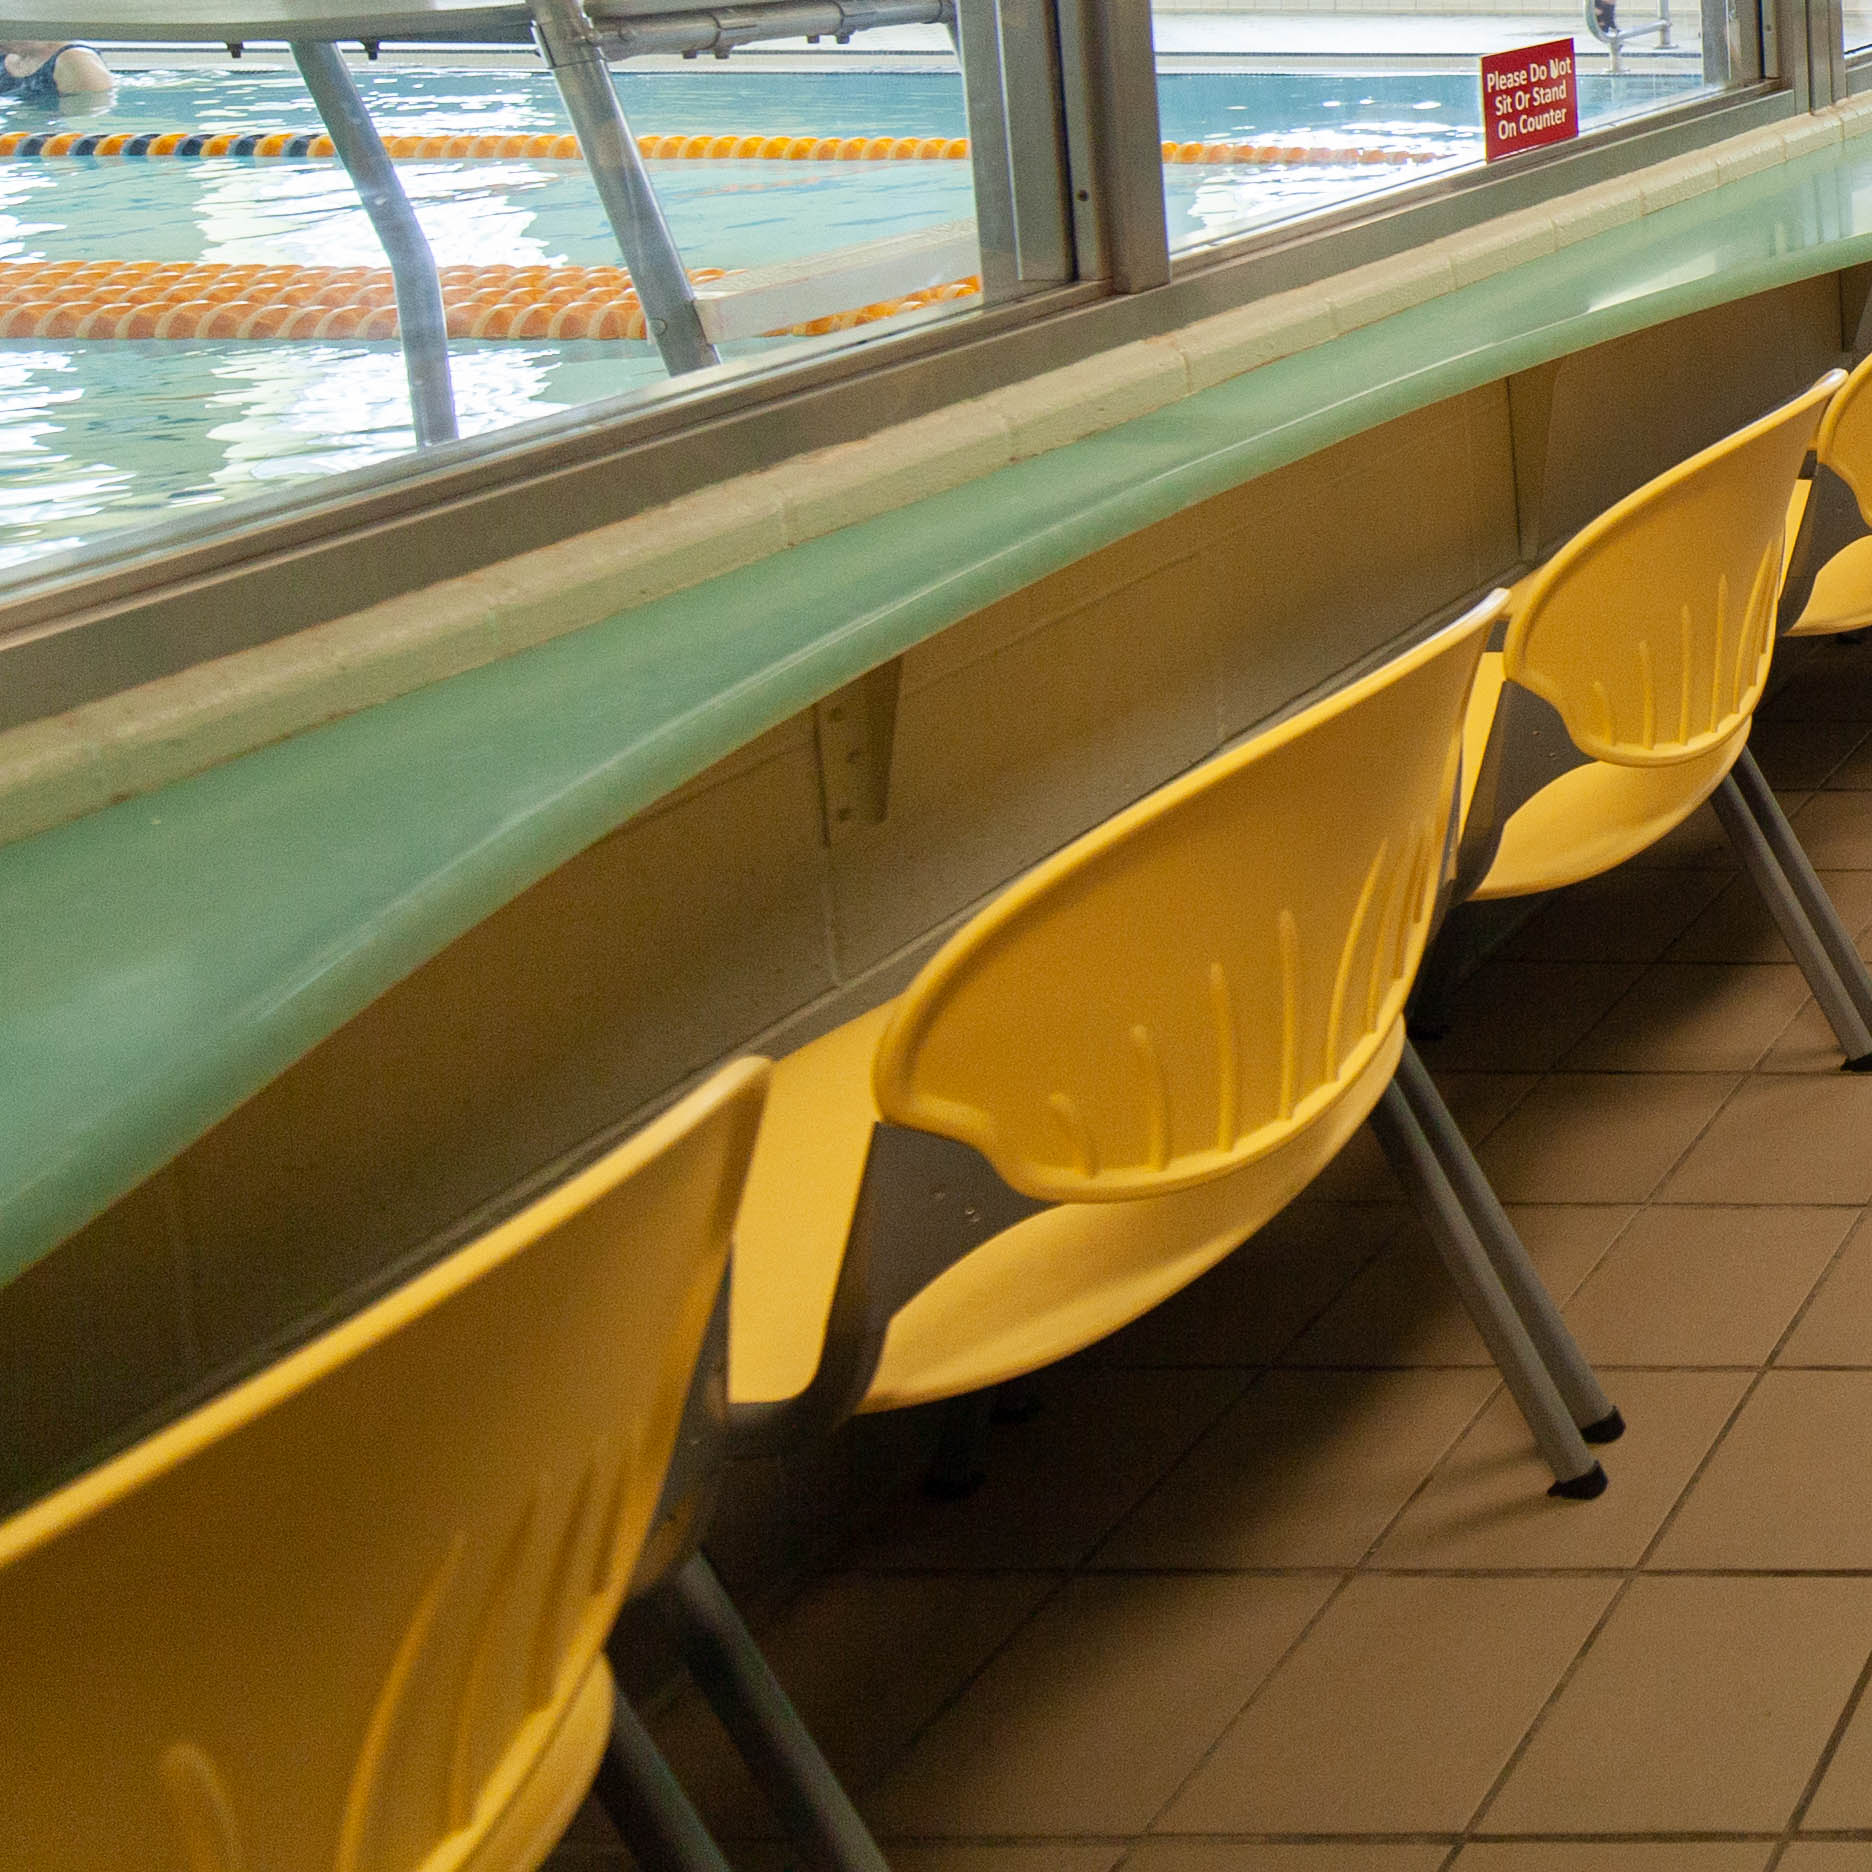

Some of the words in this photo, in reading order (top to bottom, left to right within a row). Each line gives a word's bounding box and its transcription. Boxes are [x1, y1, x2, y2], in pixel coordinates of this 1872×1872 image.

[1486, 69, 1528, 93] Please
[1529, 63, 1547, 83] Do
[1549, 57, 1572, 80] Not
[1495, 94, 1512, 116] Sit
[1515, 90, 1531, 111] Or
[1532, 79, 1567, 107] Stand
[1498, 119, 1517, 140] On
[1519, 108, 1567, 134] Counter
